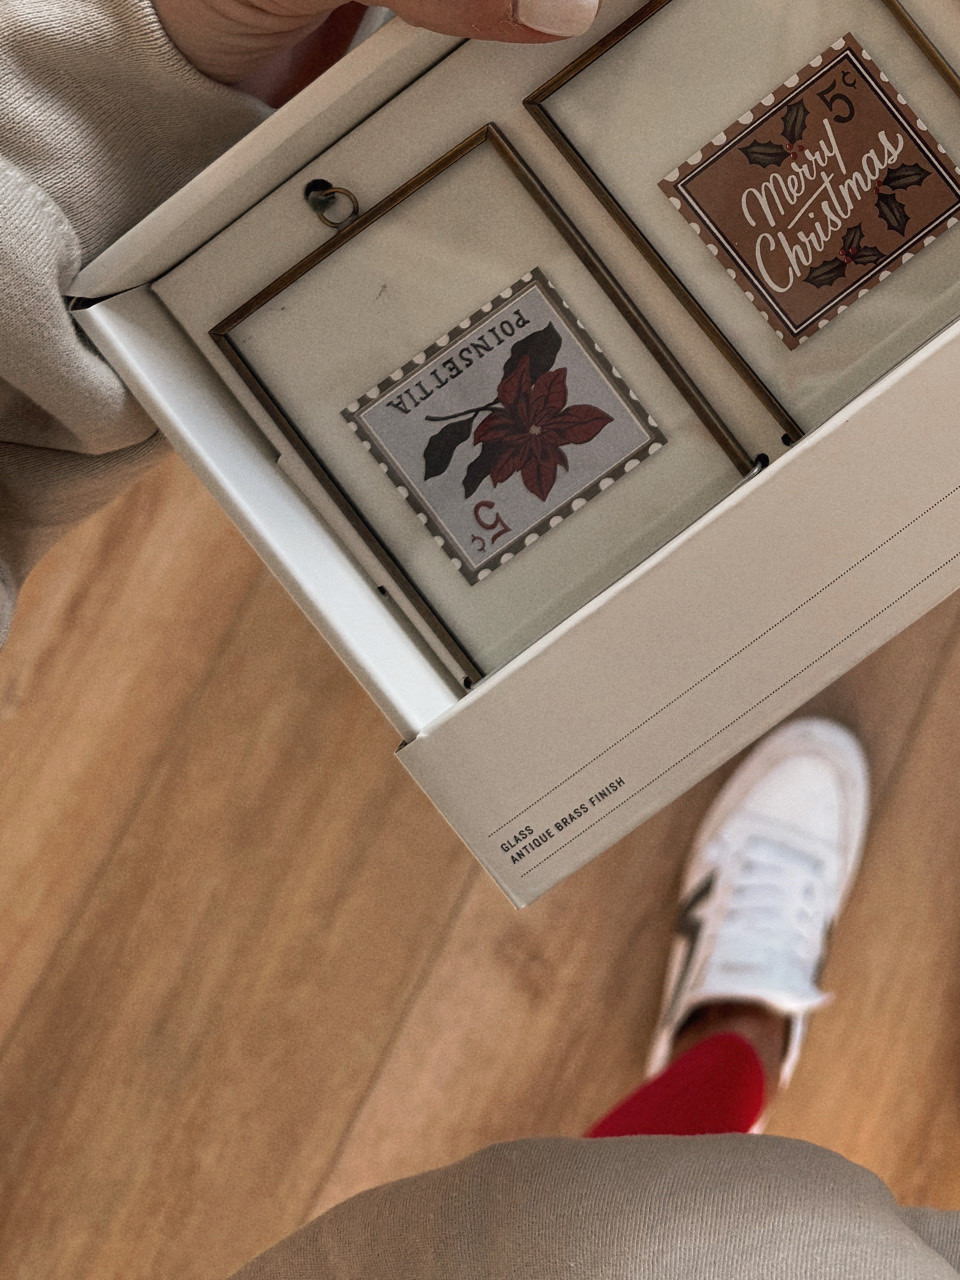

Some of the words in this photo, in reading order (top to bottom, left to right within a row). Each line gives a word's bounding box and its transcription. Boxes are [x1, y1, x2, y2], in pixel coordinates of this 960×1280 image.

[741, 118, 847, 228] Merry
[755, 130, 904, 293] Christmas
[385, 308, 532, 416] POINSETTIA
[500, 825, 534, 853] GLASS
[510, 828, 555, 865] ANTIQUE
[554, 803, 589, 832] BRASS
[588, 776, 626, 807] FINISH
